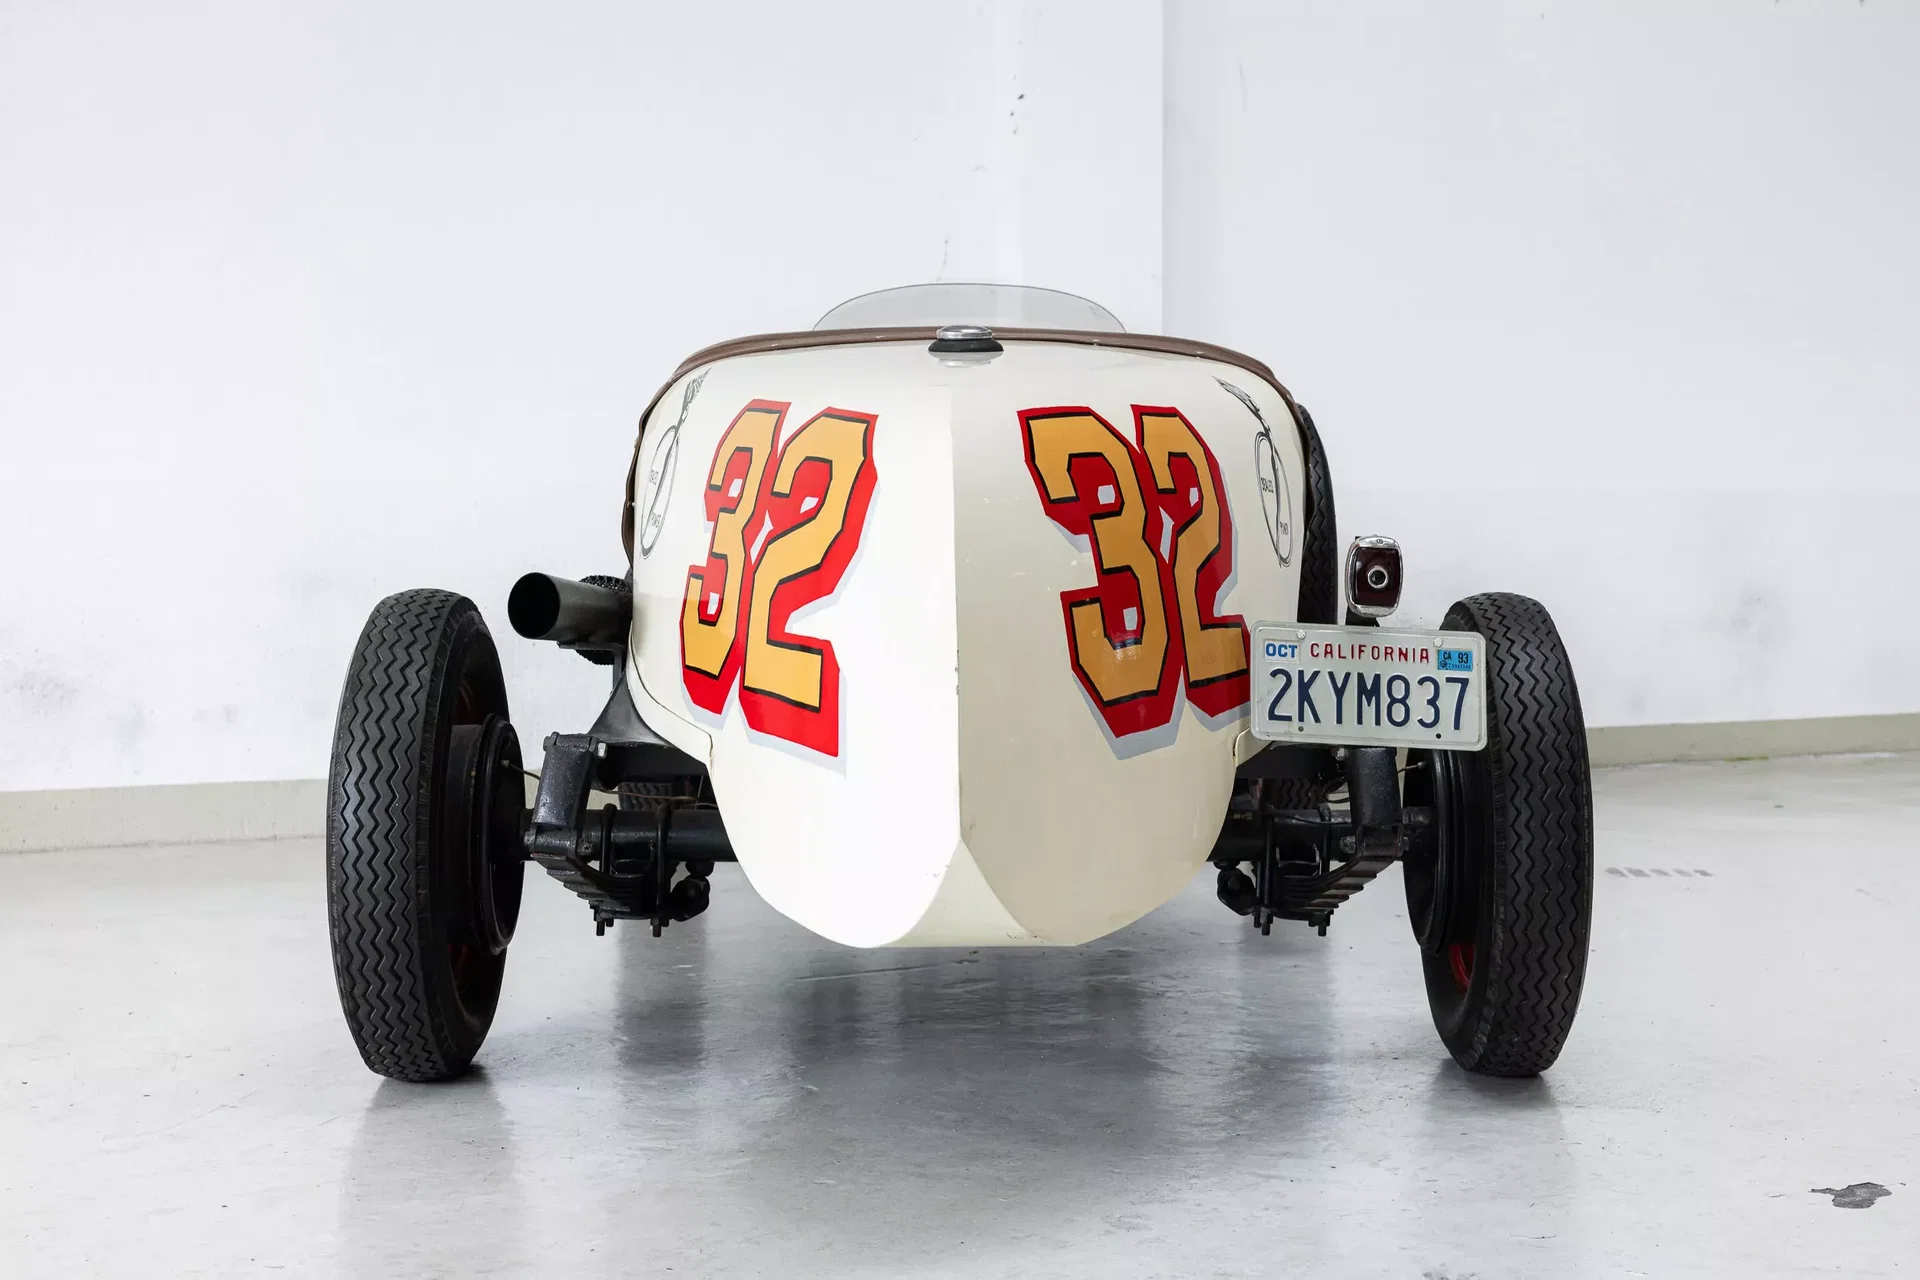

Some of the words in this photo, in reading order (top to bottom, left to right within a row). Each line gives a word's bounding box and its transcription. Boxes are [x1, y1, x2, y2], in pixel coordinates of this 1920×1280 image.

[681, 399, 879, 758] 32
[1017, 404, 1251, 739] 32
[1265, 643, 1298, 659] OCT
[1310, 642, 1429, 664] CALIFORNIA
[1443, 651, 1452, 661] CA
[1458, 652, 1469, 664] 93
[1268, 668, 1470, 731] 2KYM837
